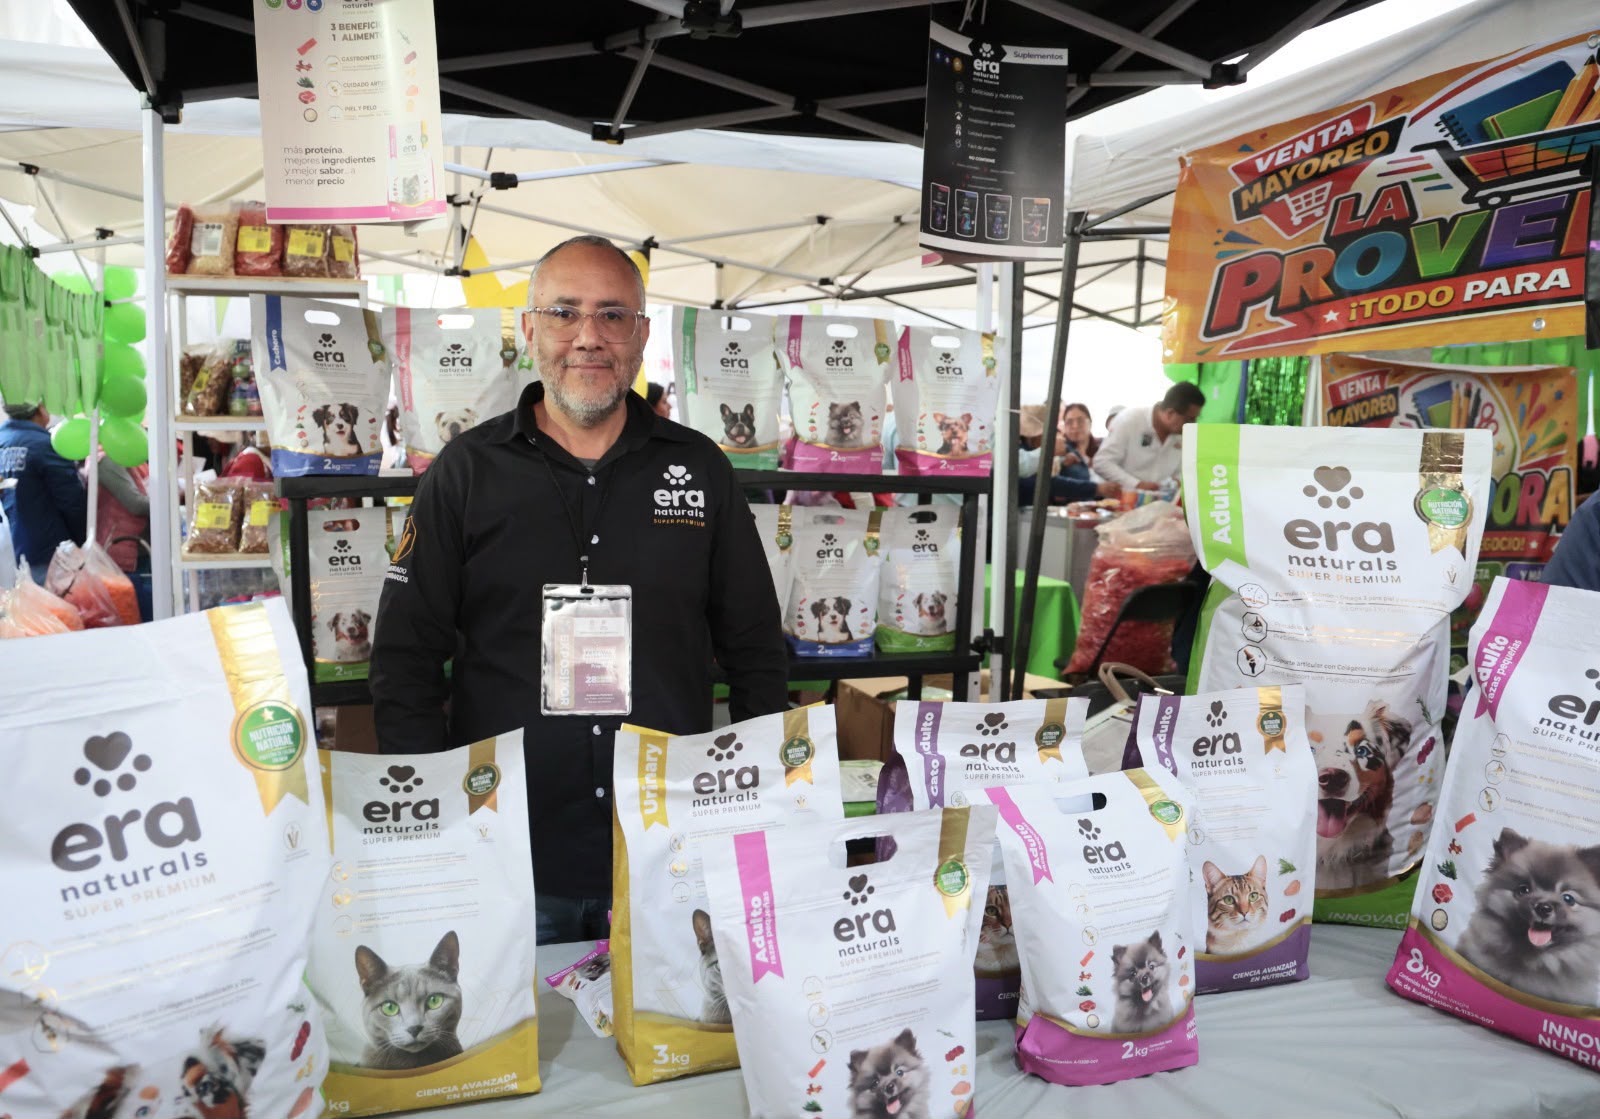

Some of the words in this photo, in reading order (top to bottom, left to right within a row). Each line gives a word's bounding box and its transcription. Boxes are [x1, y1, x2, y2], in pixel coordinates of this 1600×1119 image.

[330, 23, 336, 31] 3
[331, 33, 336, 42] 1
[1013, 50, 1064, 61] Suplementos
[973, 58, 1000, 74] era
[284, 146, 303, 154] más
[1254, 118, 1356, 174] VENTA
[285, 156, 320, 166] mejores
[321, 155, 376, 167] ingredientes
[291, 167, 318, 177] mejor
[1239, 130, 1391, 212] MAYOREO
[285, 177, 315, 186] menor
[317, 176, 345, 187] precio
[1330, 186, 1411, 237] LA
[1348, 285, 1455, 322] ¡TODO
[1463, 267, 1572, 303] PARA
[273, 329, 285, 366] Cachorro
[312, 350, 345, 364] era
[439, 356, 473, 367] era
[720, 357, 749, 369] era
[825, 356, 853, 367] era
[936, 365, 963, 376] era
[1338, 377, 1382, 401] VENTA
[1328, 393, 1398, 427] MAYOREO
[653, 489, 705, 509] era
[1209, 463, 1233, 545] Adulto
[1489, 467, 1574, 531] ORA
[653, 517, 674, 525] SUPER
[676, 518, 706, 527] PREMIUM
[654, 508, 705, 519] naturals
[1283, 518, 1396, 554] era
[816, 547, 844, 559] era
[912, 541, 939, 554] era
[328, 554, 361, 566] era
[1288, 554, 1398, 572] naturals
[1287, 568, 1331, 581] SUPER
[1336, 570, 1402, 585] PREMIUM
[1296, 661, 1323, 669] articular
[1496, 639, 1522, 676] pequeñas
[559, 634, 571, 706] EXPOSITOR
[1487, 675, 1502, 704] razas
[249, 722, 294, 743] NUTRICIÓN
[919, 711, 935, 755] dulto
[1156, 705, 1174, 754] Adulto
[1532, 726, 1574, 743] SUPER
[255, 734, 294, 752] NATURAL
[1192, 732, 1243, 757] era
[959, 742, 1017, 764] era
[1191, 756, 1244, 769] naturals
[965, 763, 1021, 773] naturals
[991, 772, 1025, 780] PREMIUM
[1213, 767, 1247, 776] PREMIUM
[643, 742, 663, 816] Urinary
[692, 764, 760, 796] era
[692, 790, 759, 809] naturals
[362, 798, 440, 823] era
[692, 807, 720, 818] SUPER
[722, 802, 762, 815] PREMIUM
[50, 796, 202, 872] era
[363, 822, 439, 835] naturals
[362, 836, 394, 846] SUPER
[396, 831, 441, 843] PREMIUM
[1015, 824, 1043, 870] Adulto
[1082, 840, 1127, 865] era
[60, 851, 209, 902] naturals
[1088, 862, 1132, 875] naturals
[63, 898, 124, 921] SUPER
[131, 872, 217, 904] PREMIUM
[750, 895, 769, 963] Adulto
[832, 907, 897, 943] era
[766, 938, 777, 965] razas
[838, 935, 900, 958] naturals
[839, 955, 866, 968] SUPER
[868, 947, 904, 962] PREMIUM
[1232, 969, 1261, 980] CIENCIA
[1261, 960, 1297, 975] AVANZADA
[1260, 968, 1297, 982] NUTRICIÓN
[1398, 971, 1421, 988] Contenido
[1420, 983, 1434, 995] Neto
[1403, 983, 1411, 991] de
[1538, 1033, 1600, 1068] NUTRI
[415, 1084, 459, 1098] CIENCIA
[461, 1072, 518, 1091] AVANZADA
[446, 1090, 460, 1100] EN
[463, 1081, 518, 1099] NUTRICIÓN
[328, 1099, 350, 1112] kg
